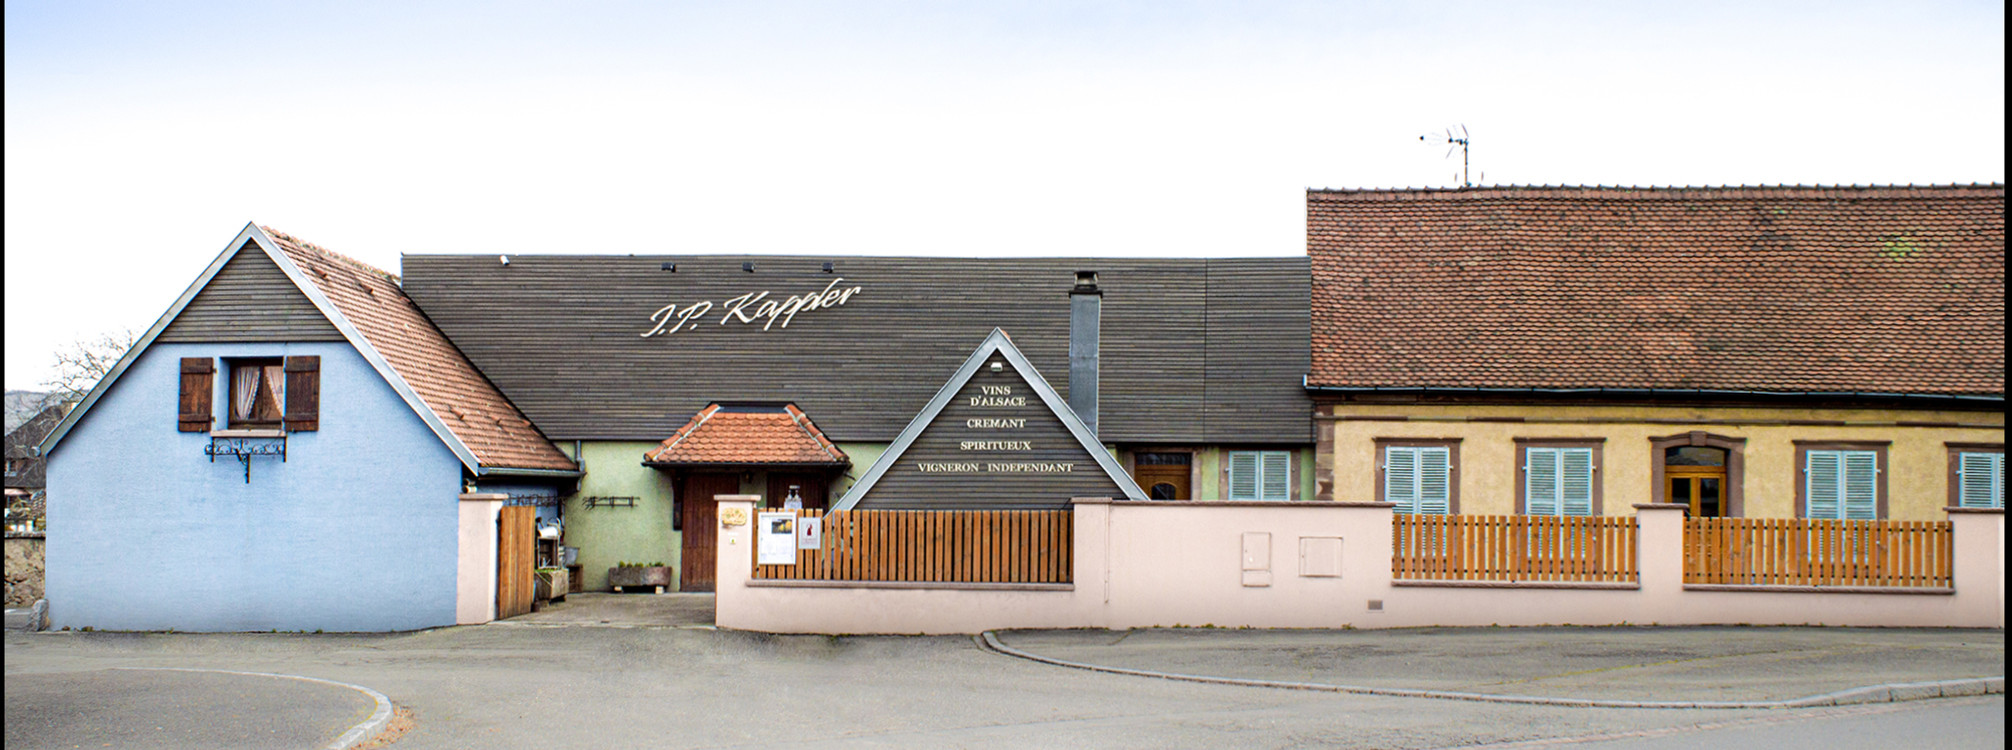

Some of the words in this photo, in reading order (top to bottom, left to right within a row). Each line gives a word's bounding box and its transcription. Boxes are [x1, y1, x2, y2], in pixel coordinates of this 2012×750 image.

[720, 277, 861, 332] Kappler
[981, 386, 1011, 395] VINS
[970, 396, 1026, 406] D'ALSACE
[967, 419, 1026, 428] CREMANT
[960, 441, 1031, 450] SPIRITUEUX
[918, 463, 979, 472] VIGNERON
[988, 463, 1074, 472] INDEPENDANT
